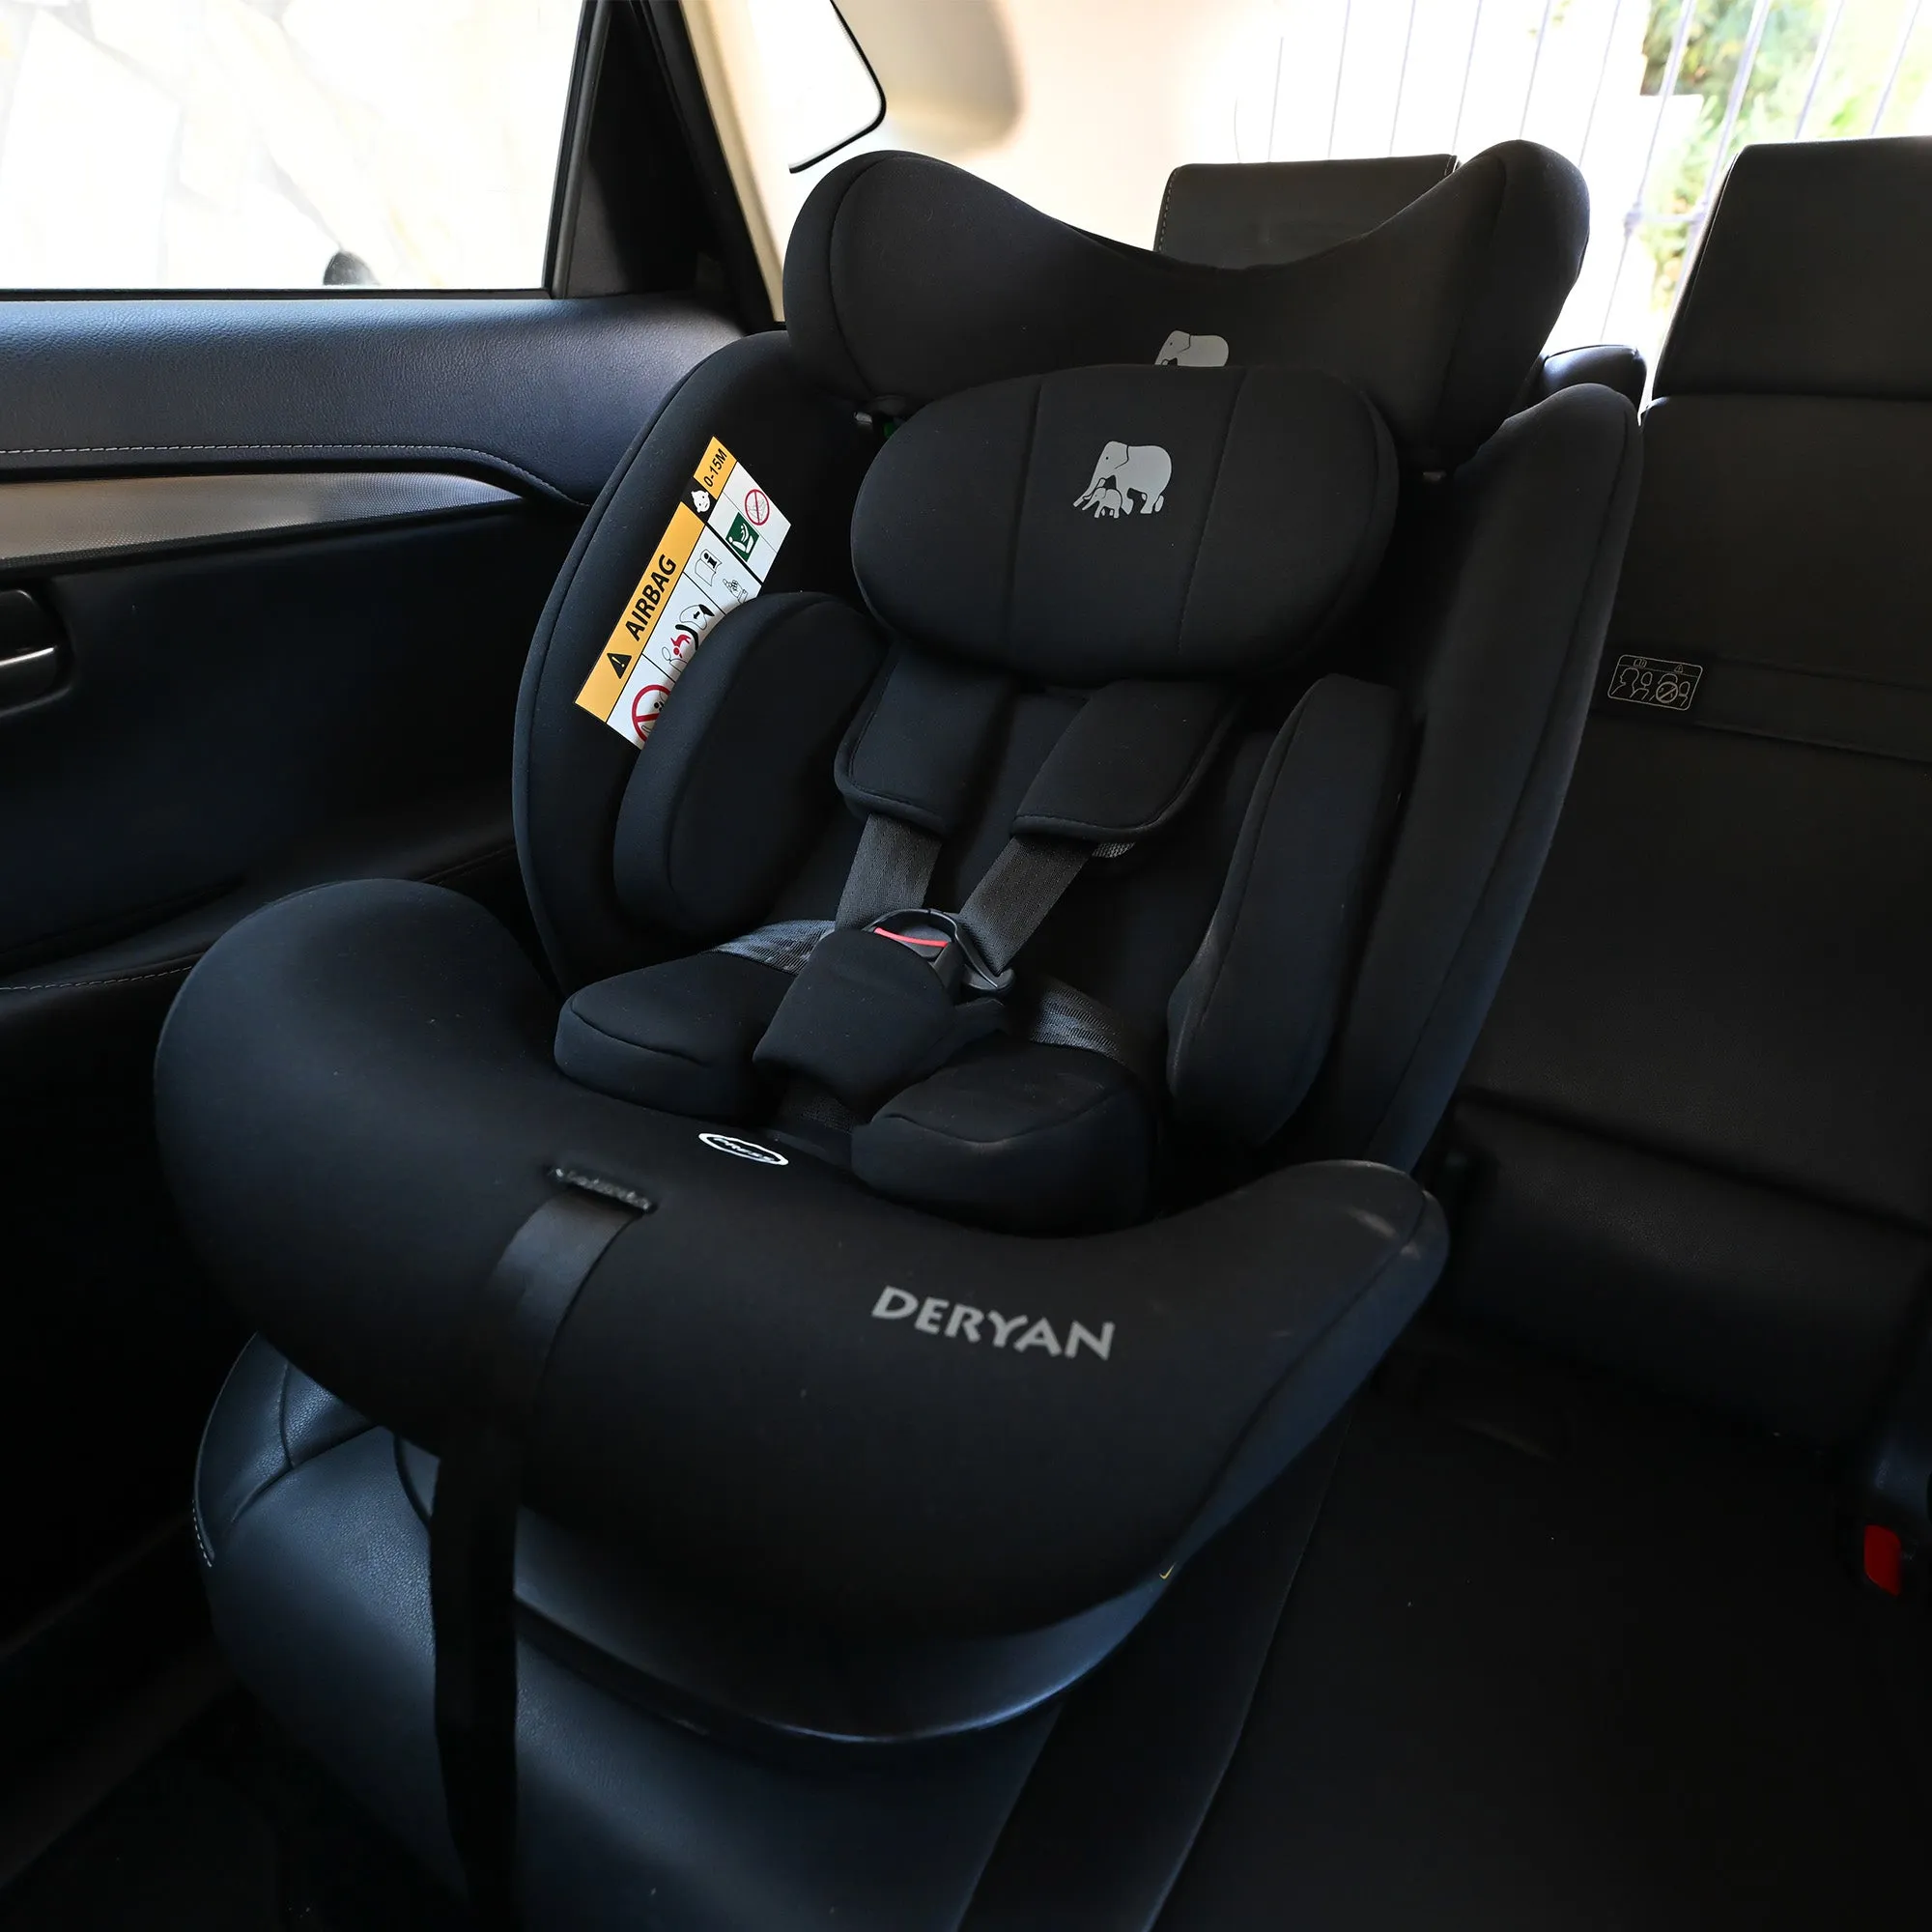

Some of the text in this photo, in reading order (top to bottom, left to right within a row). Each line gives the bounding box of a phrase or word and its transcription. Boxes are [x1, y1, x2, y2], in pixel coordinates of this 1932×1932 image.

[702, 447, 728, 488] 0-15M
[624, 554, 676, 641] AIRBAG
[870, 1285, 1116, 1361] DERYAN
